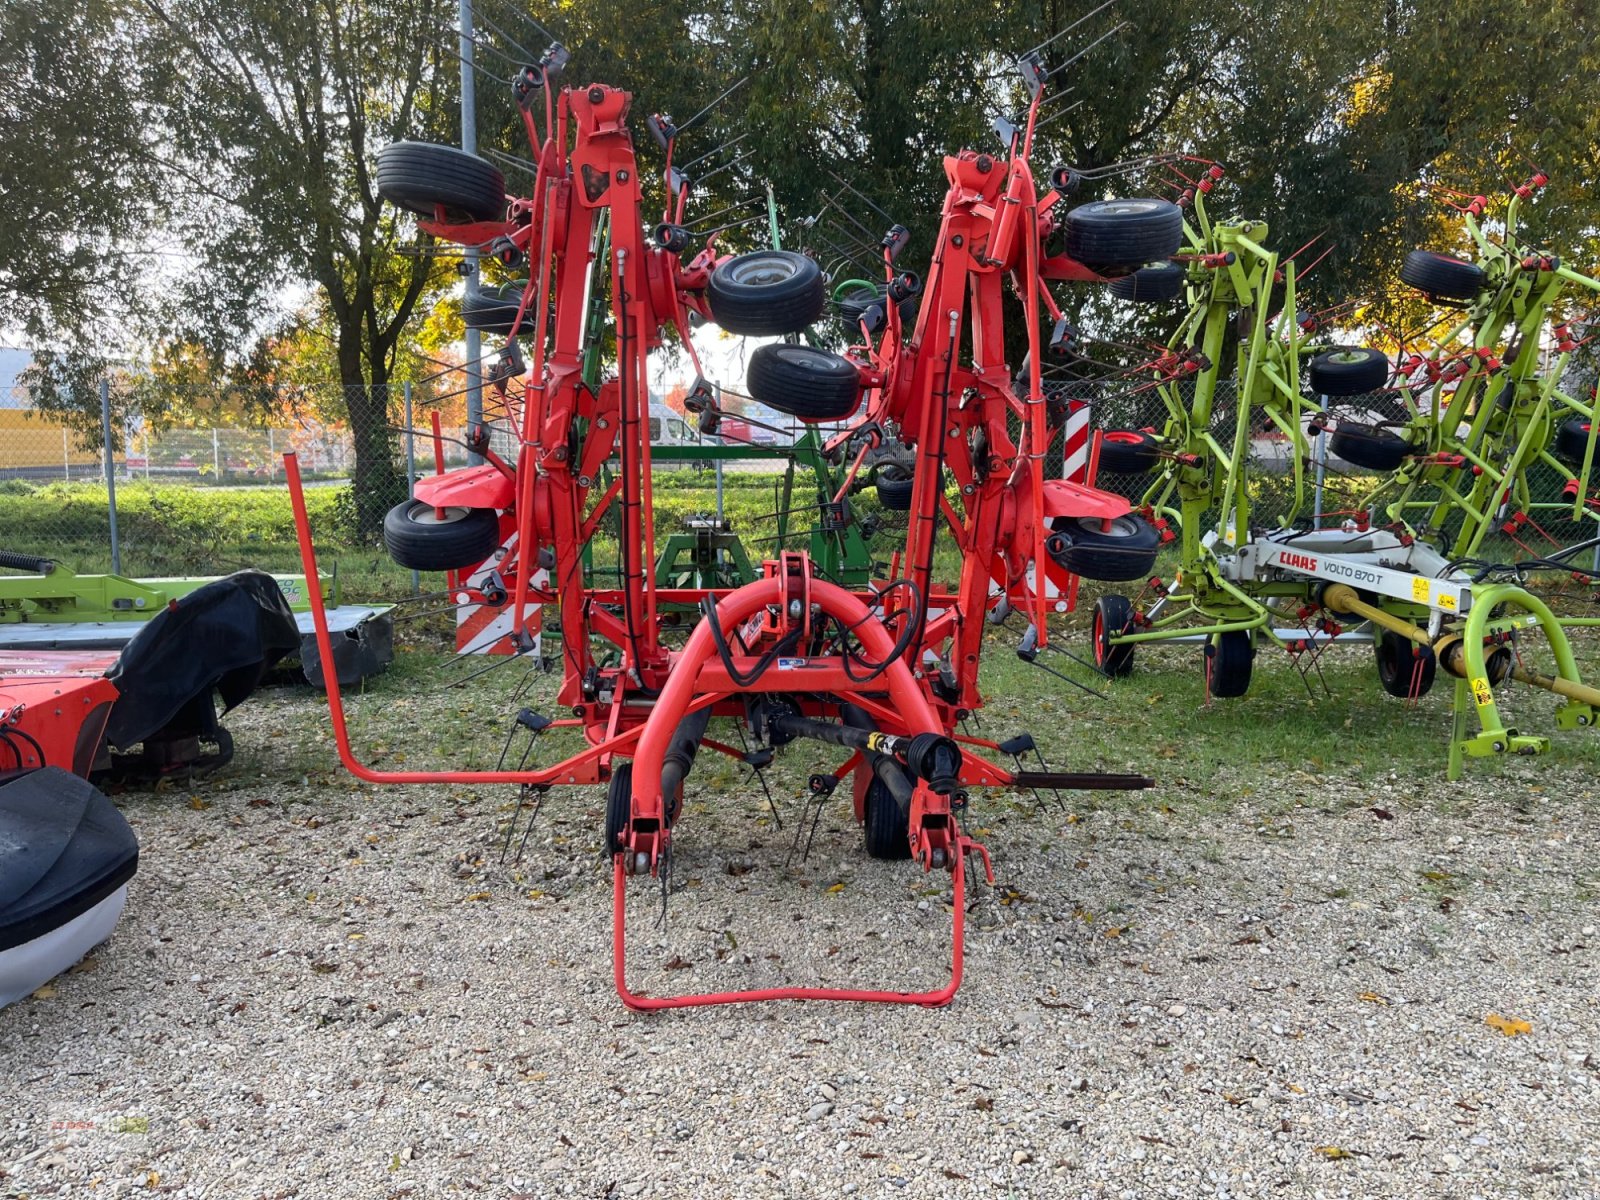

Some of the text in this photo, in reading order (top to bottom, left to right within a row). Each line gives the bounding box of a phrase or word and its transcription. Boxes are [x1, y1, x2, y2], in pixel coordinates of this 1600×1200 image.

[1280, 551, 1383, 584] CLAAS VOLTO 870 T
